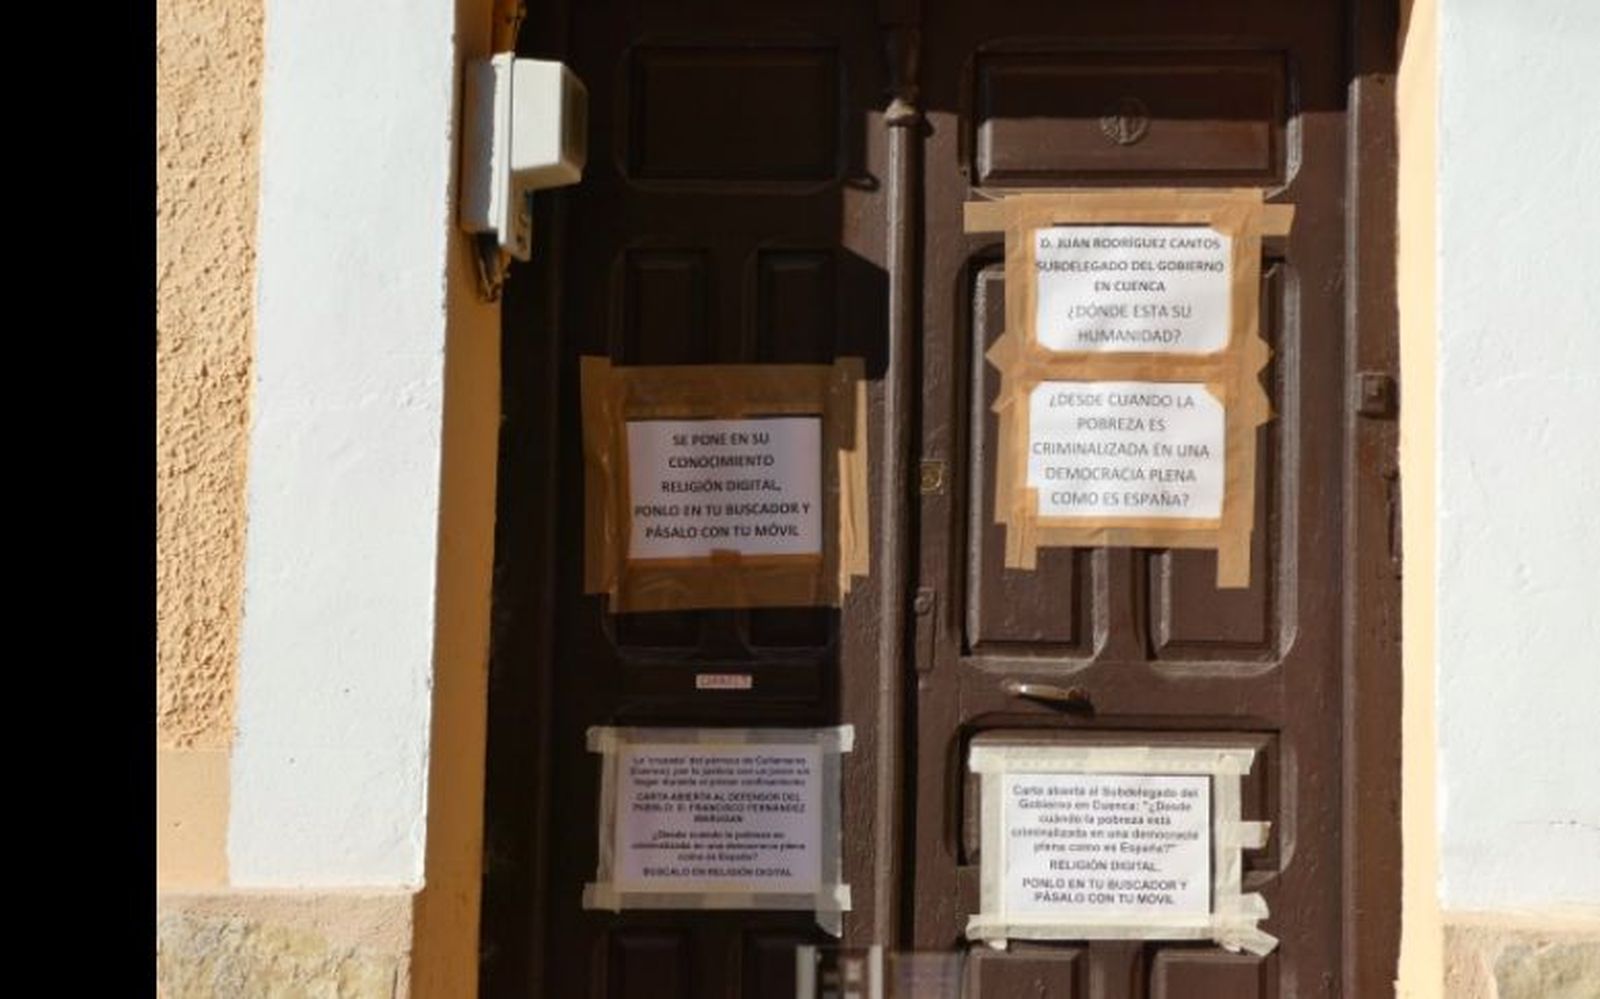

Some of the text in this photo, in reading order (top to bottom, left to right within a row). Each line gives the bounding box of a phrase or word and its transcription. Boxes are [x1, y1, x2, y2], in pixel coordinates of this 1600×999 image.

[1040, 237, 1221, 248] D. JUAN RODRÍGUEZ CANTOS
[1036, 261, 1224, 272] SUBDELEGADO DEL GOBIERNO
[1094, 281, 1165, 292] EN CUENCA
[1067, 304, 1128, 318] ¿DÓNDE
[1171, 305, 1191, 318] SU
[1078, 330, 1182, 342] HUMANIDAD?
[1050, 393, 1194, 408] ¿DESDE CUANDO LA
[1077, 418, 1165, 431] POBREZA ES
[673, 433, 769, 446] SE PONE EN SU
[1032, 443, 1210, 458] CRIMINALIZADA EN UNA
[669, 455, 775, 468] CONOCIMIENTO
[1045, 467, 1196, 481] DEMOCRACIA PLENA
[661, 479, 723, 493] RELIGIÓN
[1051, 492, 1190, 506] COMO ES ESPAÑA?
[634, 503, 810, 517] PONLO EN TU BUSCADOR Y
[645, 524, 800, 538] PÁSALO CON TU MÓVIL
[636, 793, 668, 801] CARTA
[671, 793, 711, 801] ABIERTA
[714, 793, 724, 801] AL
[728, 793, 779, 801] DEFENSOR
[1013, 785, 1044, 796] Carta
[1047, 786, 1086, 796] abierta
[1089, 787, 1099, 796] al
[1181, 788, 1199, 798] del
[1085, 815, 1094, 824] la
[1097, 816, 1143, 826] pobreza
[1091, 830, 1104, 838] en
[1108, 830, 1128, 838] una
[1068, 879, 1085, 888] EN
[1090, 879, 1104, 889] TU
[1108, 880, 1176, 890] BUSCADOR
[1181, 882, 1187, 890] Y
[1088, 894, 1114, 903] CON
[1119, 894, 1134, 904] TU
